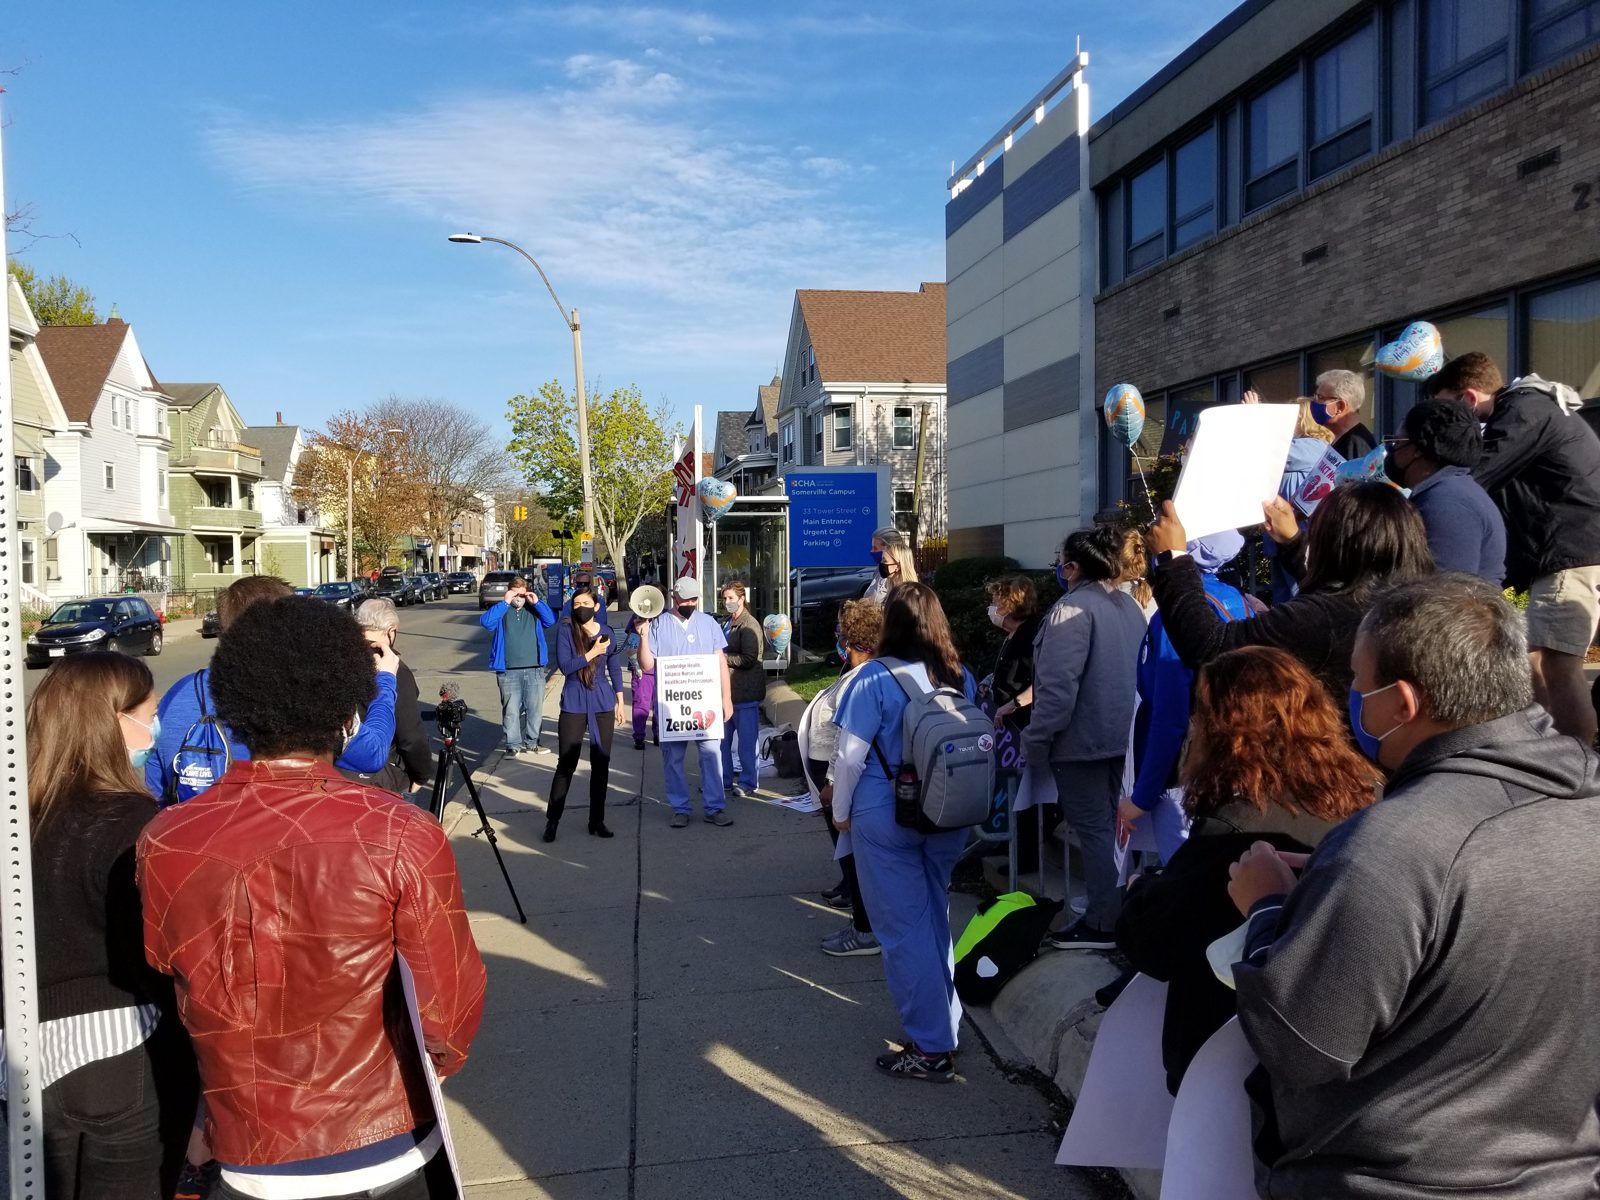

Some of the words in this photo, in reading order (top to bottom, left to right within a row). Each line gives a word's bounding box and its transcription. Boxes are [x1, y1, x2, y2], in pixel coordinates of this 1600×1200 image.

[797, 479, 816, 487] CHA
[791, 488, 827, 496] Somerville
[828, 488, 856, 496] Campus
[803, 539, 830, 547] Parking
[665, 689, 703, 702] Heroes
[680, 704, 692, 716] to
[666, 718, 698, 732] Zeros
